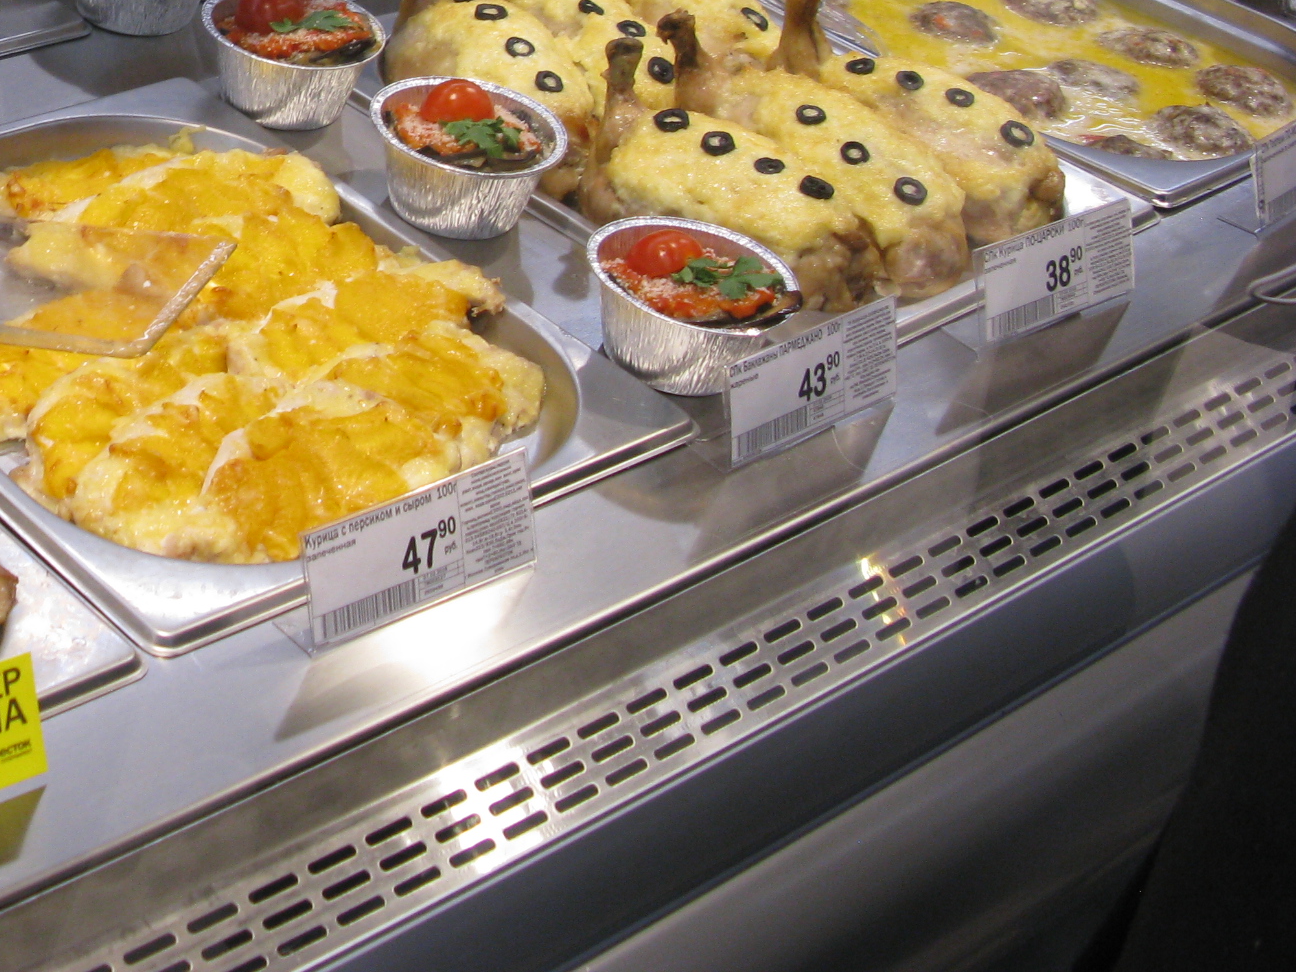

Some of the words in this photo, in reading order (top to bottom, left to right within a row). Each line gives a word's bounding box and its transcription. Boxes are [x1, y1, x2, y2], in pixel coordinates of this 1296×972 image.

[998, 242, 1024, 258] Курица
[1026, 225, 1065, 247] ПО-ЦАРСКИ
[1045, 254, 1071, 292] 38
[1070, 245, 1083, 263] 90
[744, 350, 778, 372] Баклажаны
[779, 329, 823, 356] ПАРМЕДЖАНО
[798, 362, 827, 402] 43
[826, 351, 840, 370] 90
[304, 527, 339, 551] Курица
[348, 509, 393, 533] персиком
[403, 493, 432, 513] сыром
[436, 481, 457, 500] 100г
[402, 529, 438, 574] 47
[438, 516, 457, 538] 90
